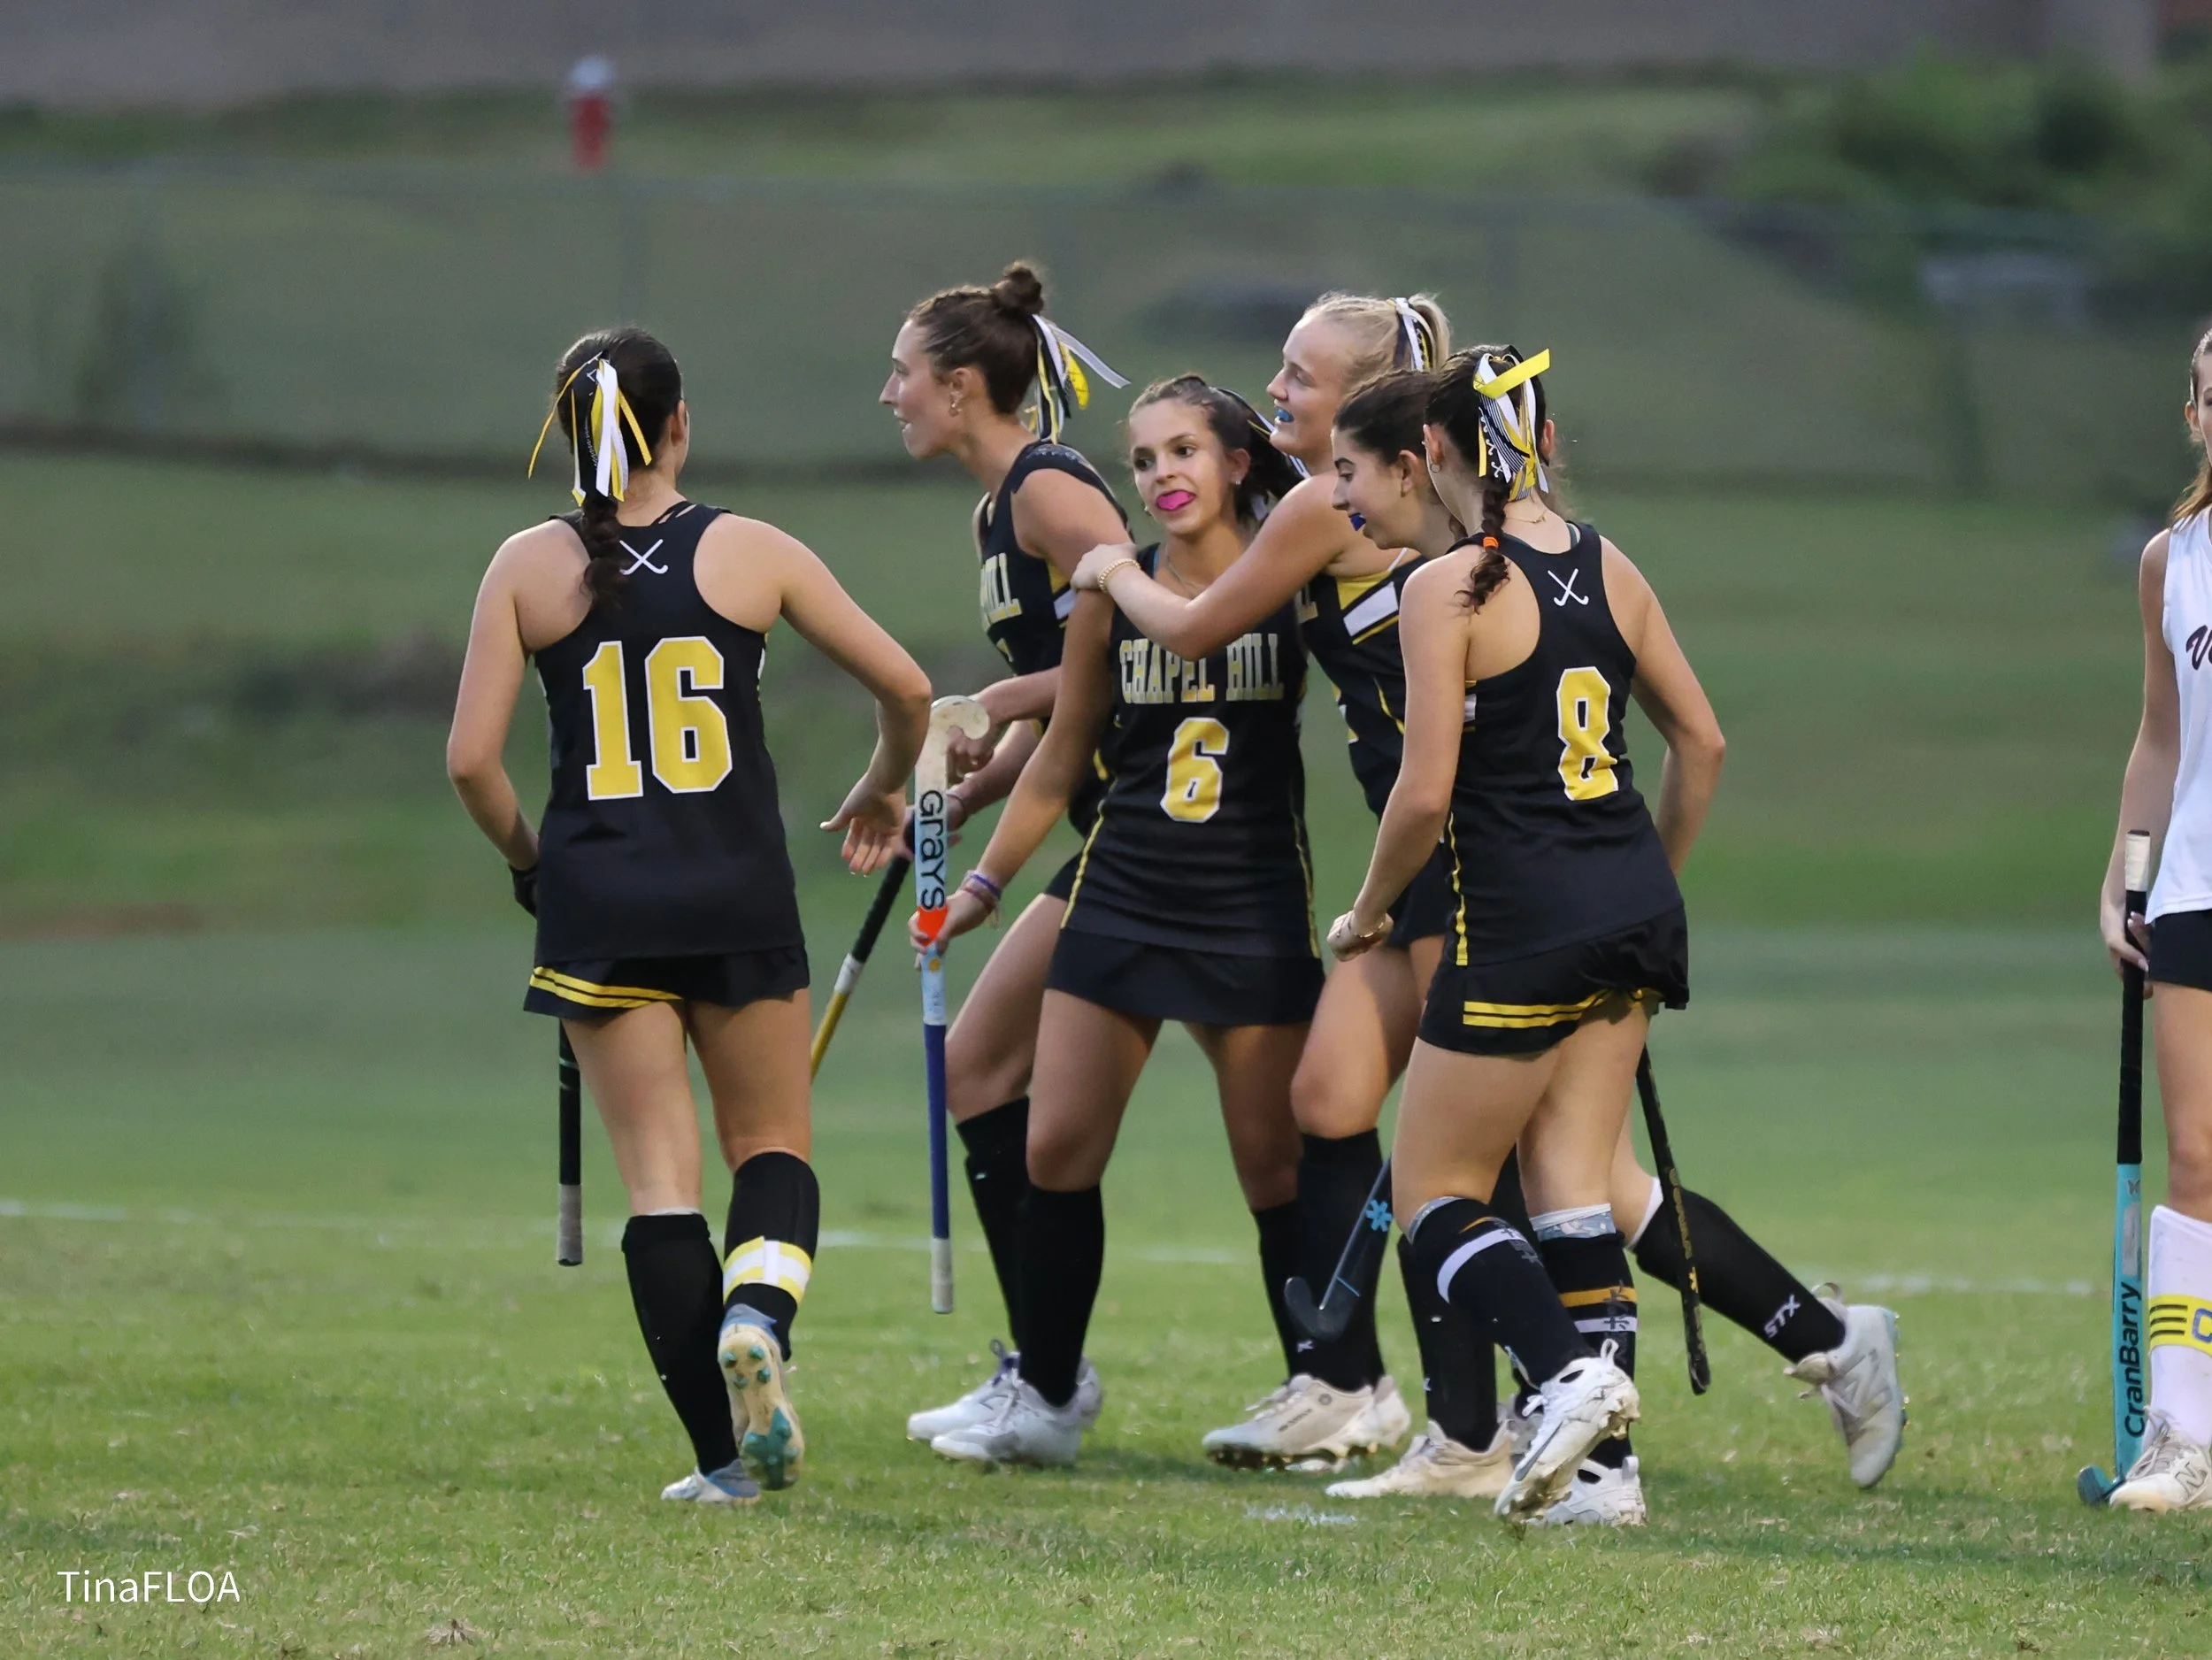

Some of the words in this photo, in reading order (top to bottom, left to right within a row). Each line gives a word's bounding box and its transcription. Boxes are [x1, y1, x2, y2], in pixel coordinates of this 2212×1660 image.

[1119, 639, 1215, 704] CHAPEL
[1226, 633, 1284, 702] HILL
[2185, 625, 2212, 671] V
[582, 636, 733, 801] 16
[1160, 717, 1230, 823] 6
[1556, 666, 1619, 802] 8
[1764, 1293, 1801, 1339] STX
[2119, 1281, 2146, 1438] CranBarry
